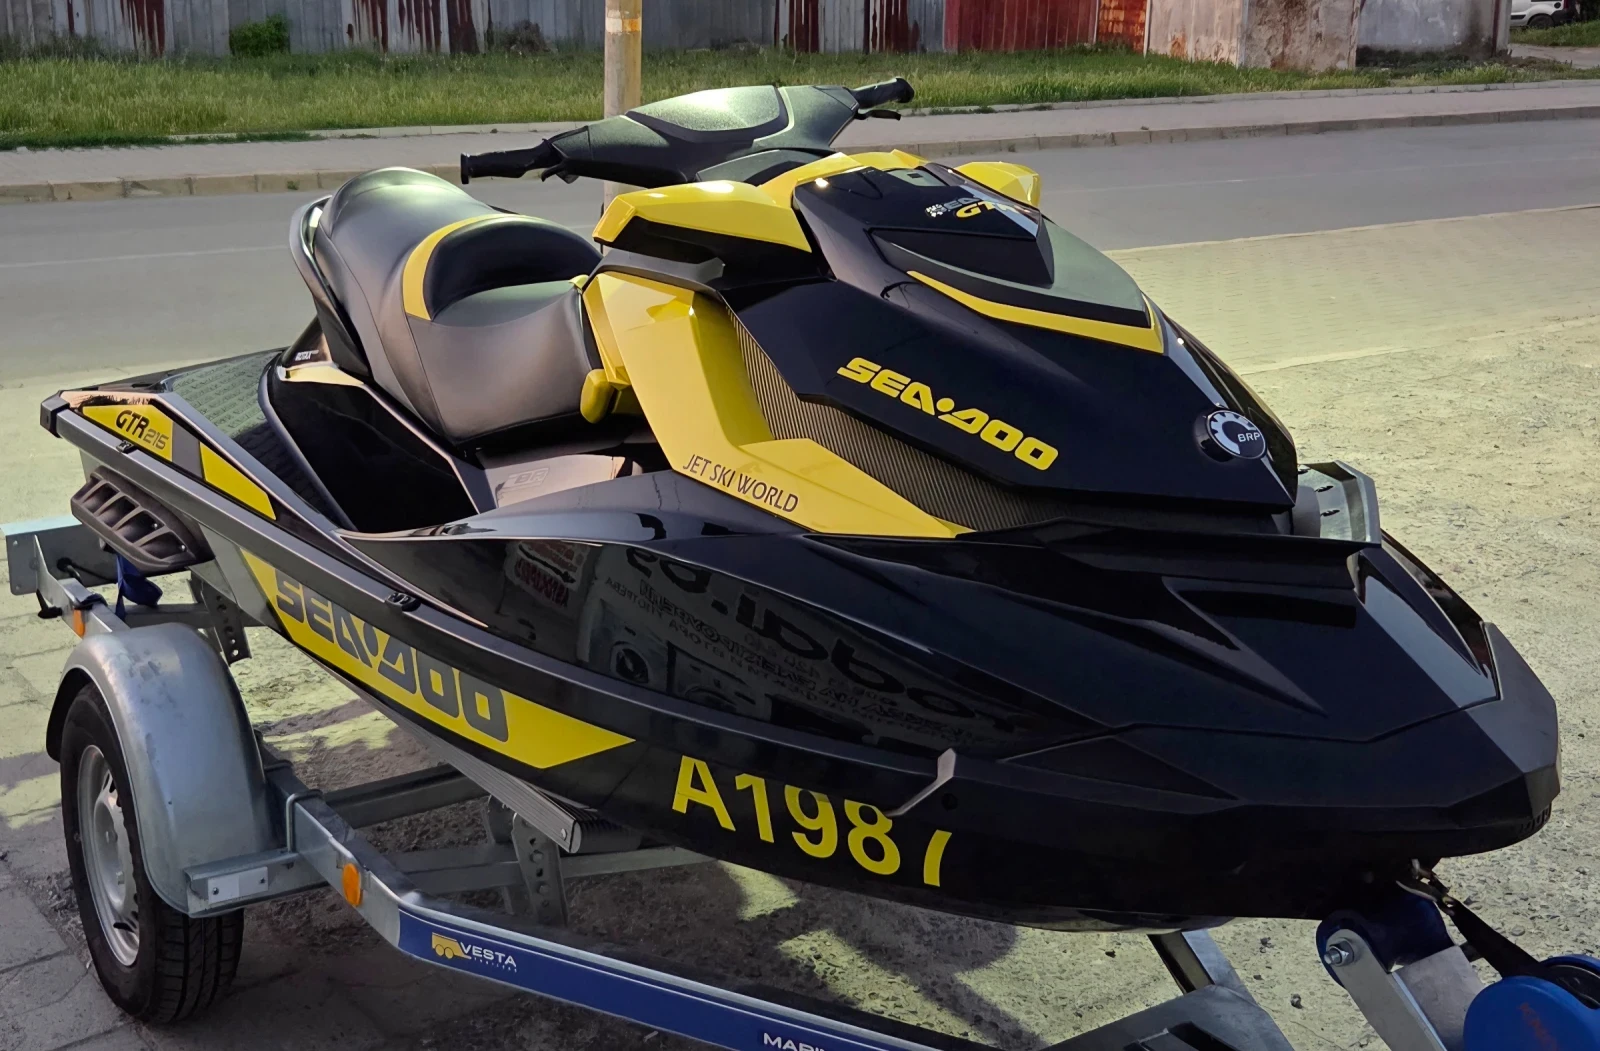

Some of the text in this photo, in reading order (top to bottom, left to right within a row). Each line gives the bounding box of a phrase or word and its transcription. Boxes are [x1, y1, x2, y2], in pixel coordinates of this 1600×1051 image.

[1237, 432, 1260, 442] BRP
[682, 454, 799, 513] JET SKI WORLD
[460, 941, 517, 968] VESTA
